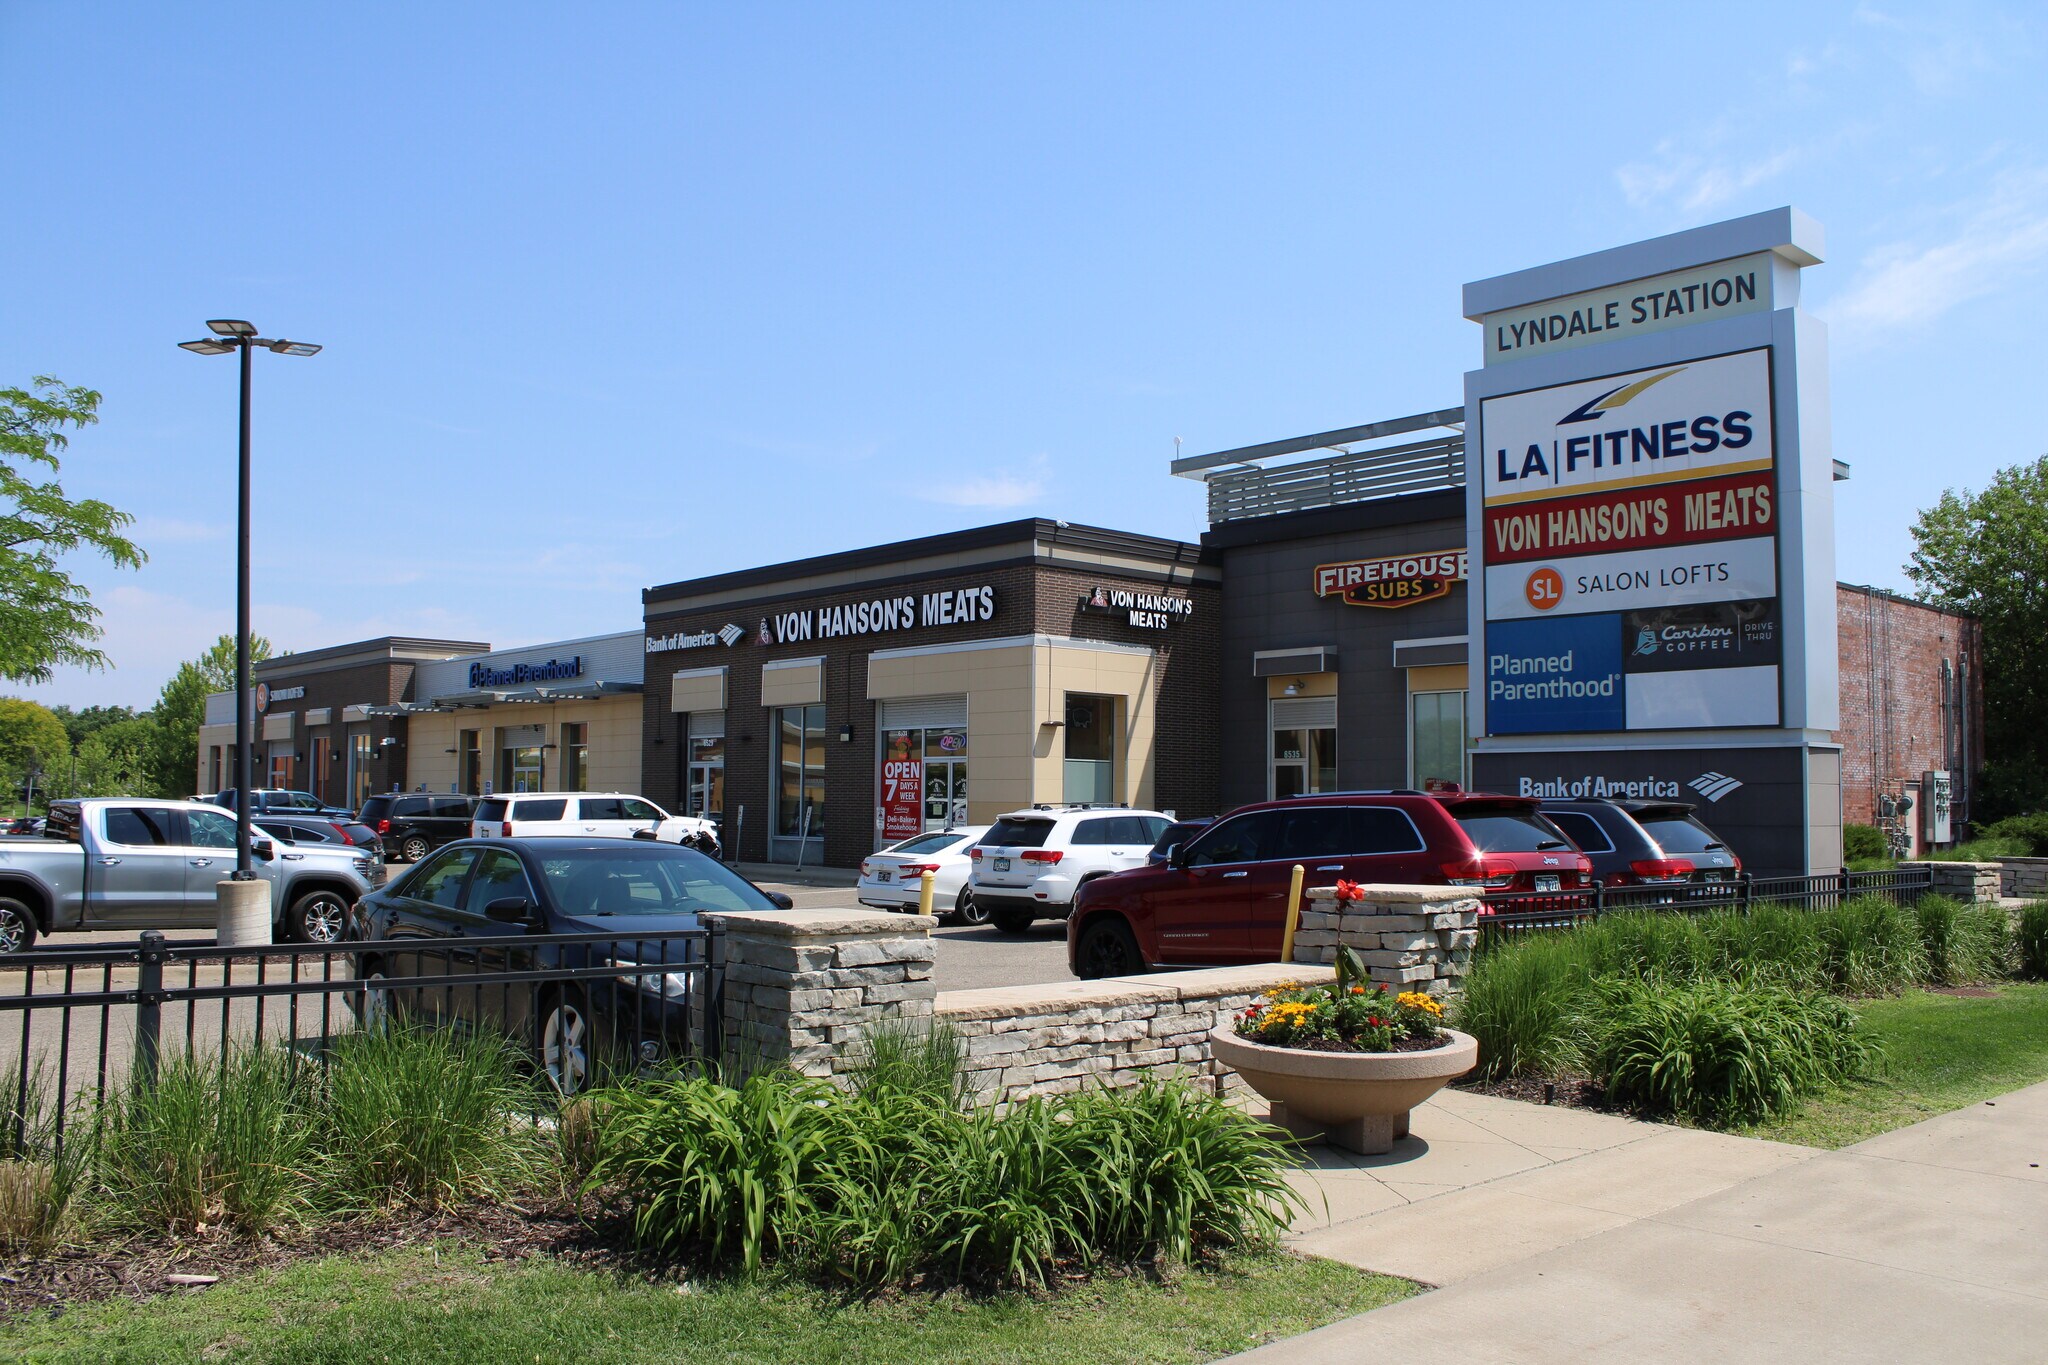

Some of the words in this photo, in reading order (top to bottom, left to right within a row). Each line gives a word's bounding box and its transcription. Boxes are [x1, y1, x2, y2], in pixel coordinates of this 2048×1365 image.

[1498, 302, 1620, 352] LYNDALE
[1631, 272, 1756, 324] STATION
[1498, 443, 1549, 482] LA
[1567, 411, 1753, 473] FITNESS
[1494, 514, 1541, 553] VON
[1548, 498, 1669, 547] HANSON'S
[1685, 485, 1772, 532] MEATS
[1320, 554, 1468, 598] FIREHOUSE
[1577, 569, 1649, 594] SALON
[1660, 562, 1729, 587] LOFTS
[1367, 579, 1423, 601] SUBS
[1532, 578, 1559, 600] SL
[1110, 590, 1134, 608] VON
[1137, 593, 1193, 615] HANSON'S
[775, 611, 812, 644] VON
[819, 596, 915, 638] HANSON'S
[922, 586, 994, 626] MEATS
[1129, 610, 1168, 630] MEATS
[646, 636, 669, 653] Bank
[669, 635, 678, 651] of
[678, 632, 716, 649] America
[1661, 624, 1734, 641] Caribou
[1746, 632, 1772, 641] THRU
[1666, 639, 1730, 652] COFFEE
[479, 664, 516, 687] Planned
[517, 656, 580, 683] Parenthood
[1490, 650, 1573, 676] Planned
[943, 735, 964, 749] OPEN
[884, 761, 920, 779] OPEN
[885, 779, 898, 802] 7
[899, 781, 914, 790] DAYS
[914, 781, 919, 790] A
[899, 791, 916, 800] WEEK
[1519, 777, 1570, 798] Bank
[1571, 776, 1592, 798] of
[1591, 776, 1680, 798] America
[1543, 856, 1560, 866] Jeep
